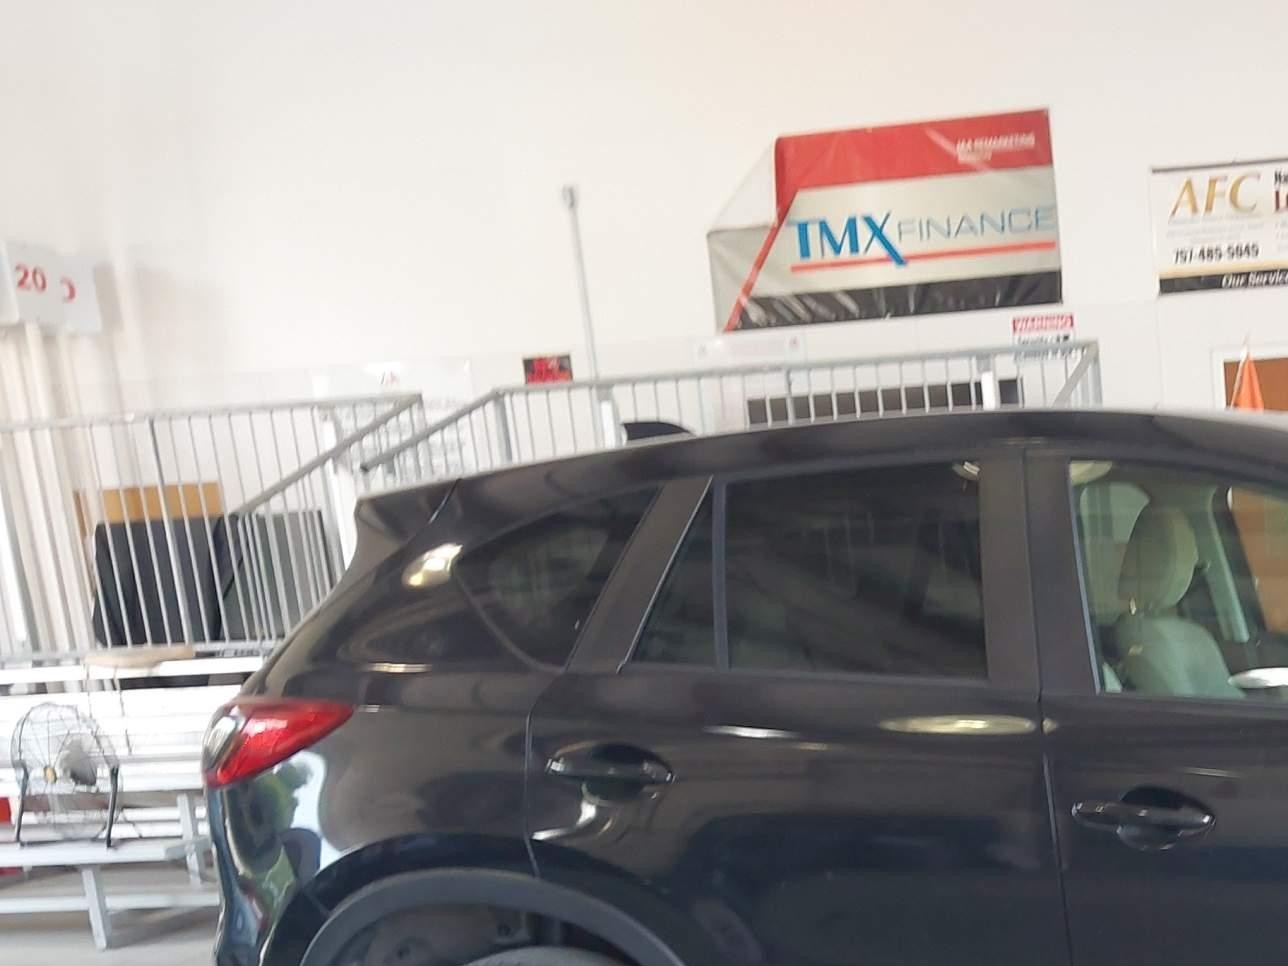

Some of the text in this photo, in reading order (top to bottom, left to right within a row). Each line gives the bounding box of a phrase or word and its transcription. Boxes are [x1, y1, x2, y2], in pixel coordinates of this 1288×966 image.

[1169, 172, 1261, 218] AFC
[15, 261, 47, 294] 20
[1221, 272, 1247, 289] Our
